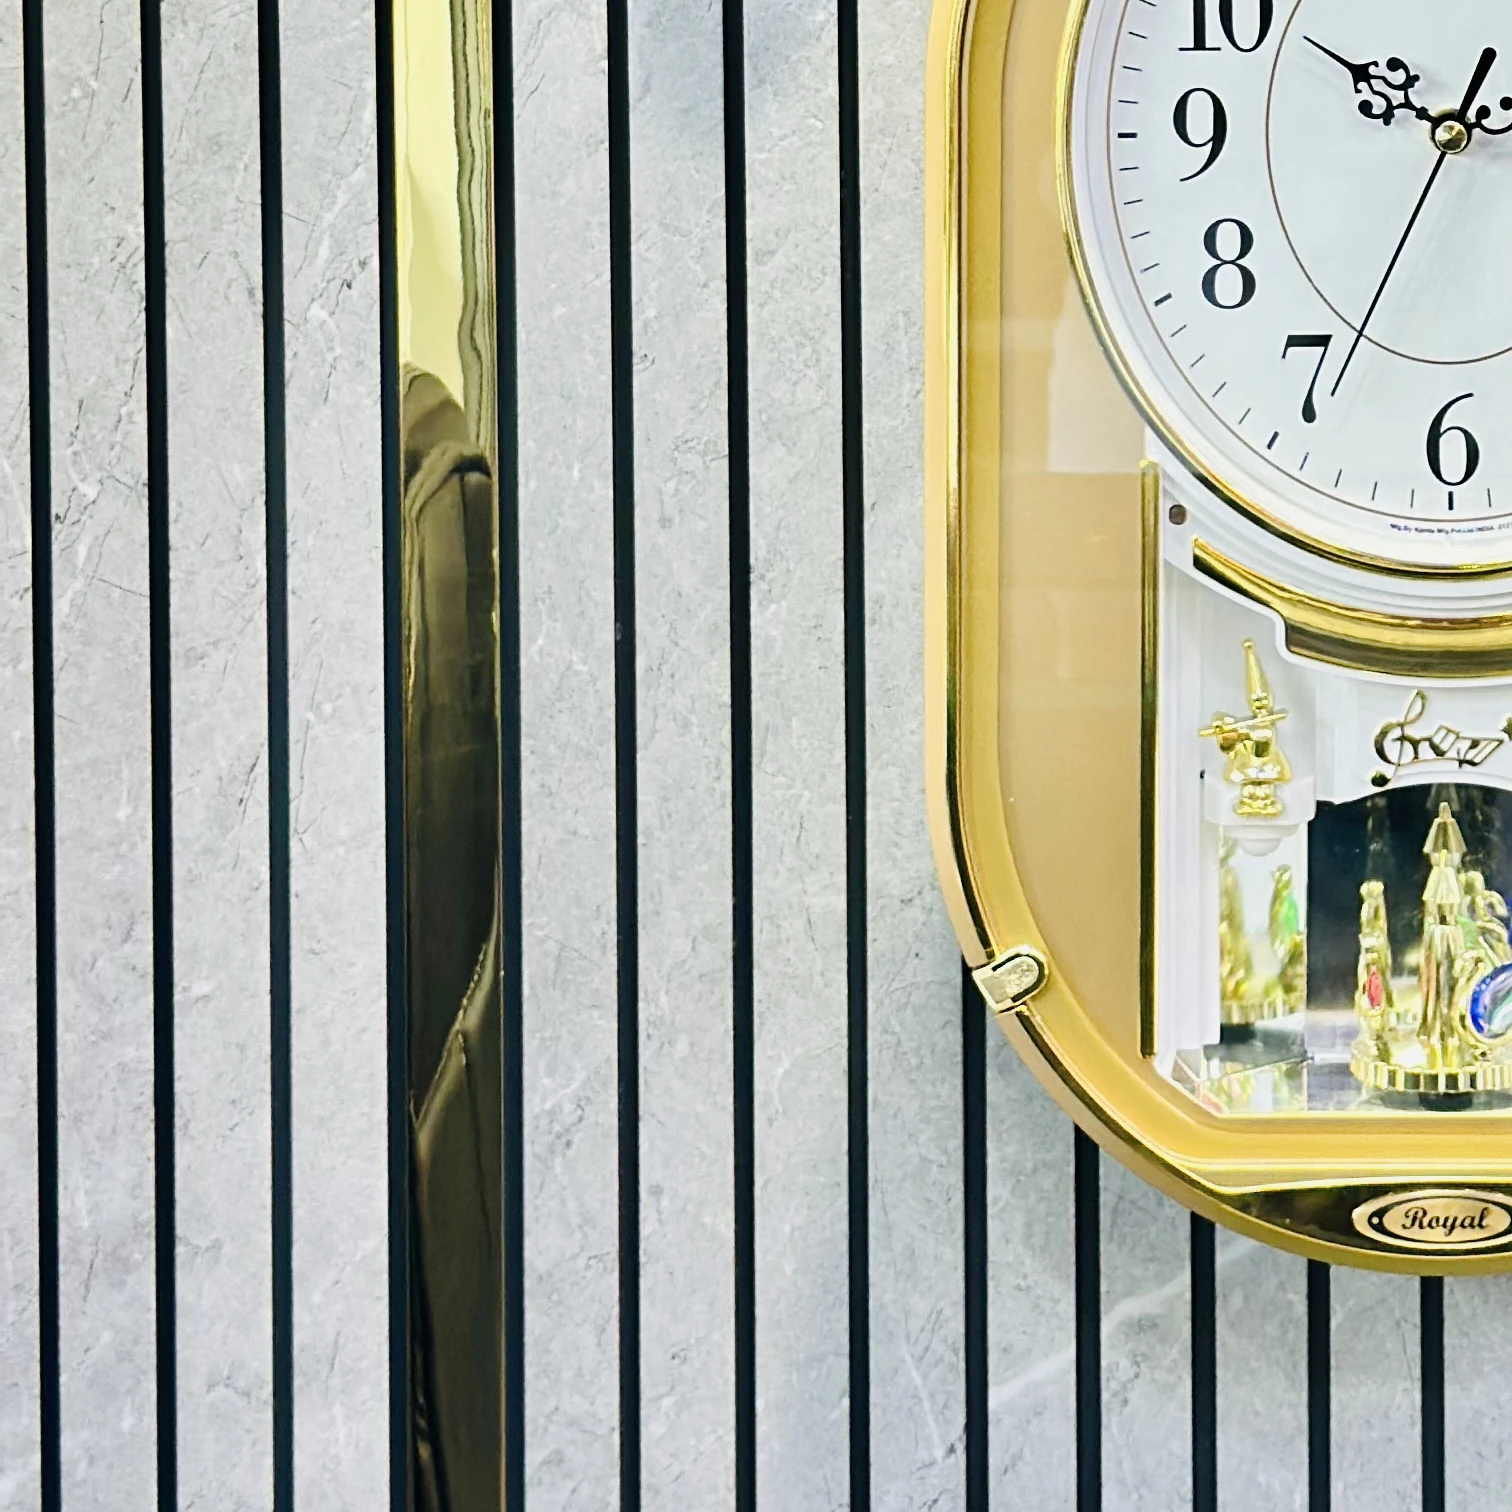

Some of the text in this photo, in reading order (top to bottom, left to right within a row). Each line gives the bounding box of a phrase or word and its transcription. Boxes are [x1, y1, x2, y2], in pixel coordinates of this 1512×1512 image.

[1173, 88, 1228, 182] 9
[1202, 219, 1257, 310] 8
[1282, 335, 1333, 424] 7
[1427, 393, 1480, 487] 6
[1401, 1205, 1491, 1238] Royal
